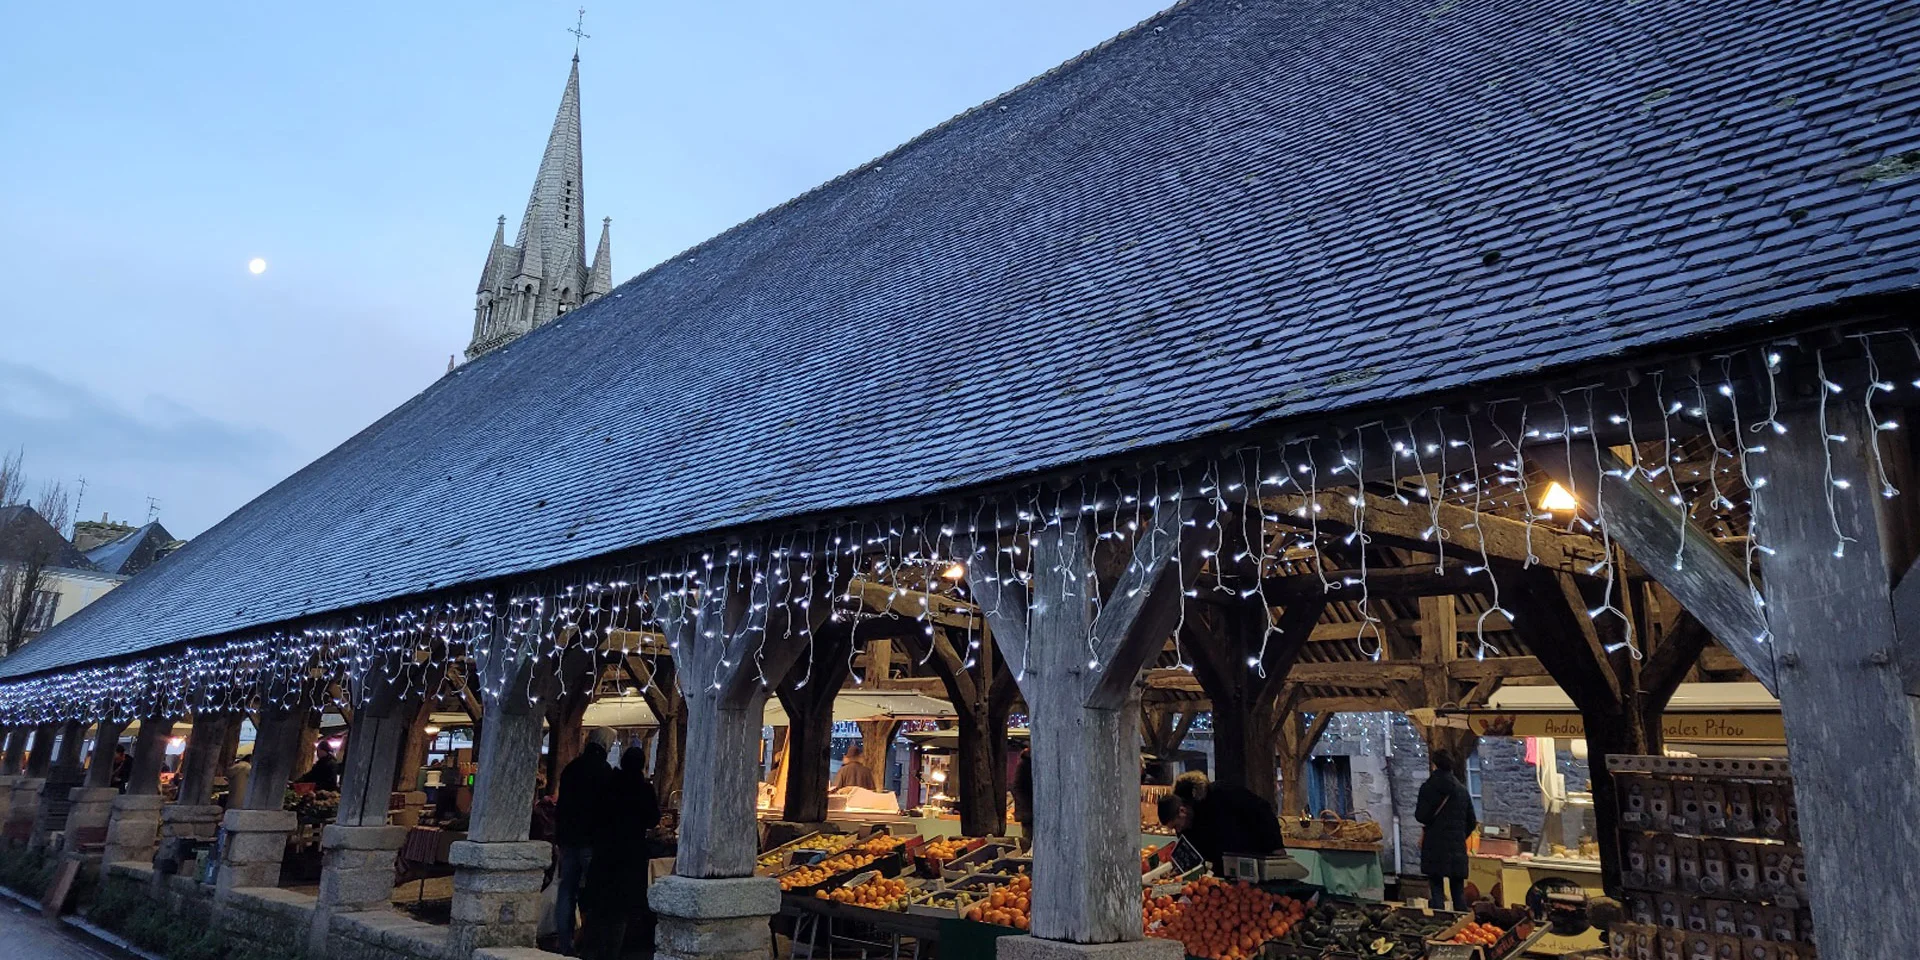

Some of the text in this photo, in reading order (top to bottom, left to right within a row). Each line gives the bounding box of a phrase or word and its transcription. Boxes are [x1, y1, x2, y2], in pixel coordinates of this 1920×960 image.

[1544, 718, 1744, 736] Andou nales Pitou
